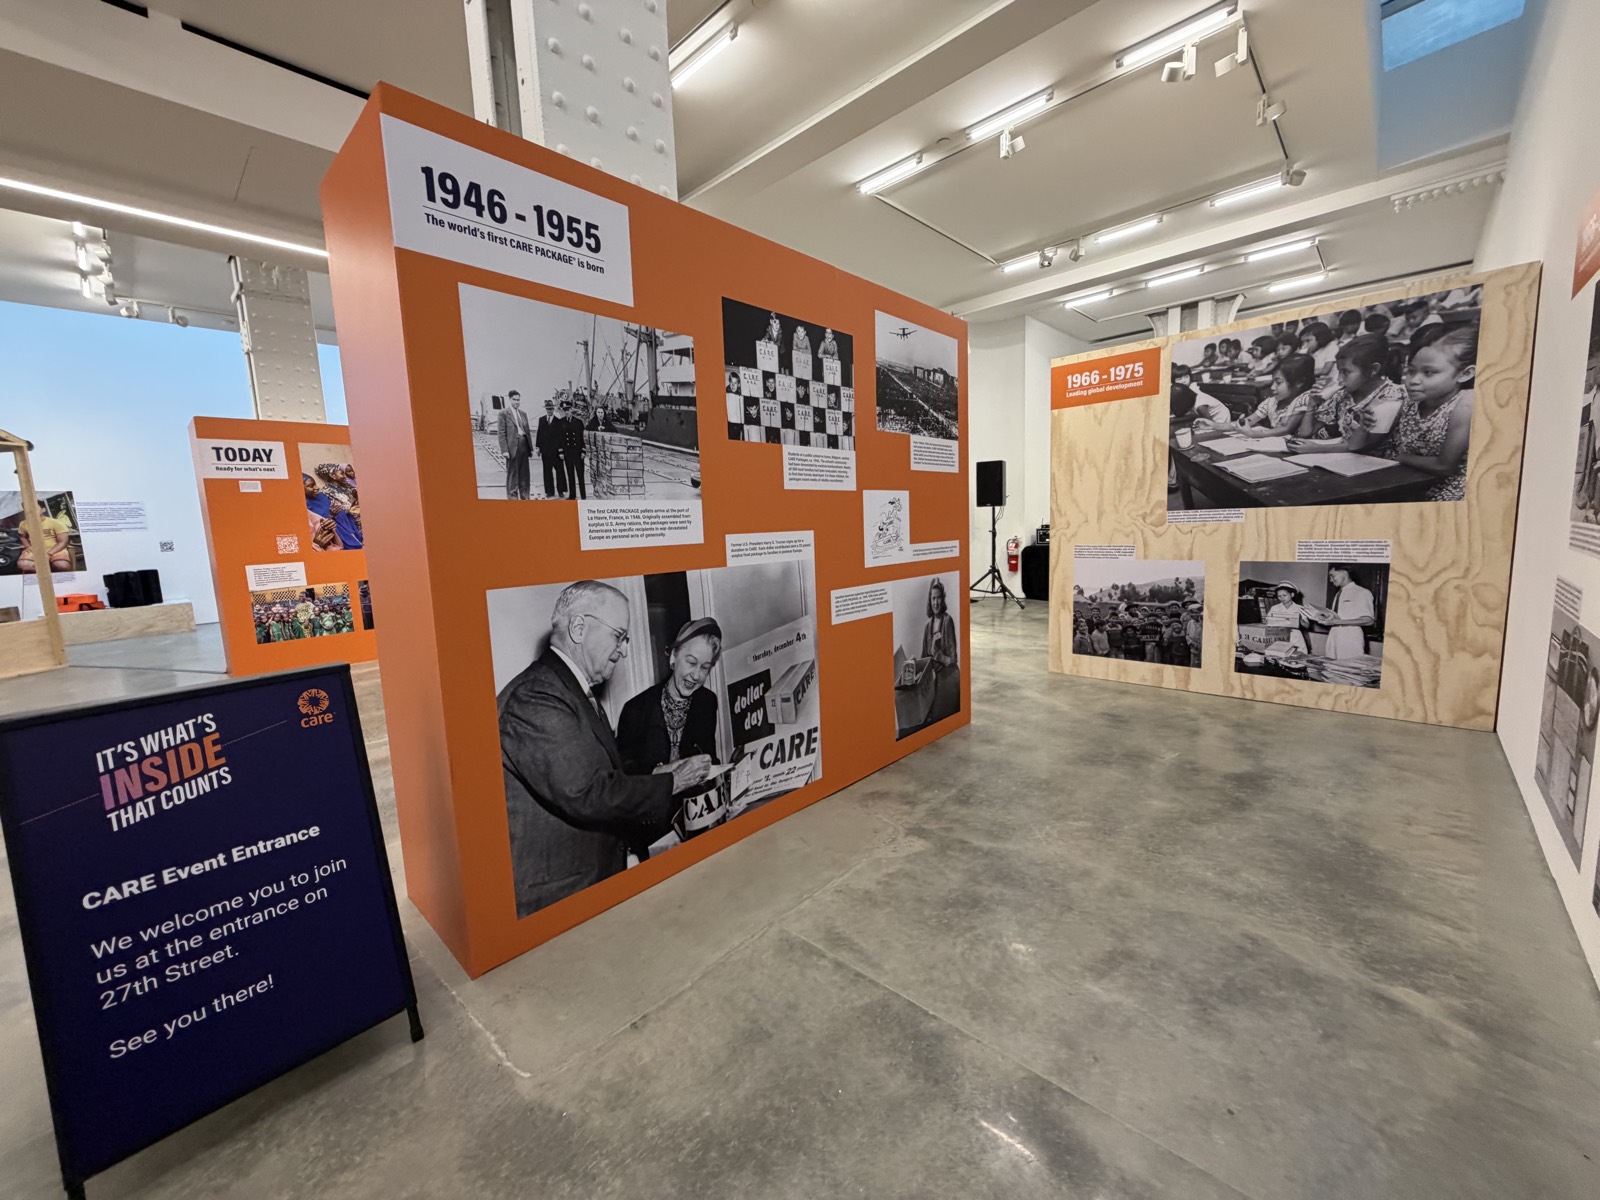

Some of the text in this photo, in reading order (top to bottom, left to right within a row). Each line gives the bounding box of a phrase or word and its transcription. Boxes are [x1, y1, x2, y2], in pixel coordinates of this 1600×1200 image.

[421, 166, 508, 225] 1946
[533, 204, 602, 254] 1955
[424, 212, 445, 228] The
[448, 220, 485, 240] world's
[487, 232, 508, 246] first
[510, 238, 533, 254] CARE
[577, 258, 584, 269] is
[586, 260, 604, 274] born
[1066, 370, 1100, 388] 1966
[1110, 362, 1144, 382] 1975
[1066, 380, 1144, 398] Leading global development
[211, 446, 273, 462] TODAY
[734, 682, 765, 714] dollar
[796, 668, 815, 704] CARE
[96, 713, 216, 773] IT'S WHAT'S
[300, 712, 334, 728] care
[744, 706, 764, 731] day
[760, 726, 818, 770] CARE
[100, 732, 226, 811] INSIDE
[106, 766, 232, 832] THAT COUNTS
[785, 766, 797, 775] 22
[82, 824, 320, 910] CARE Event Entrance
[90, 858, 347, 959] We welcome you to join
[96, 887, 328, 984] us at the entrance on
[100, 944, 240, 1010] 27th Street.
[109, 974, 274, 1059] See you there!
